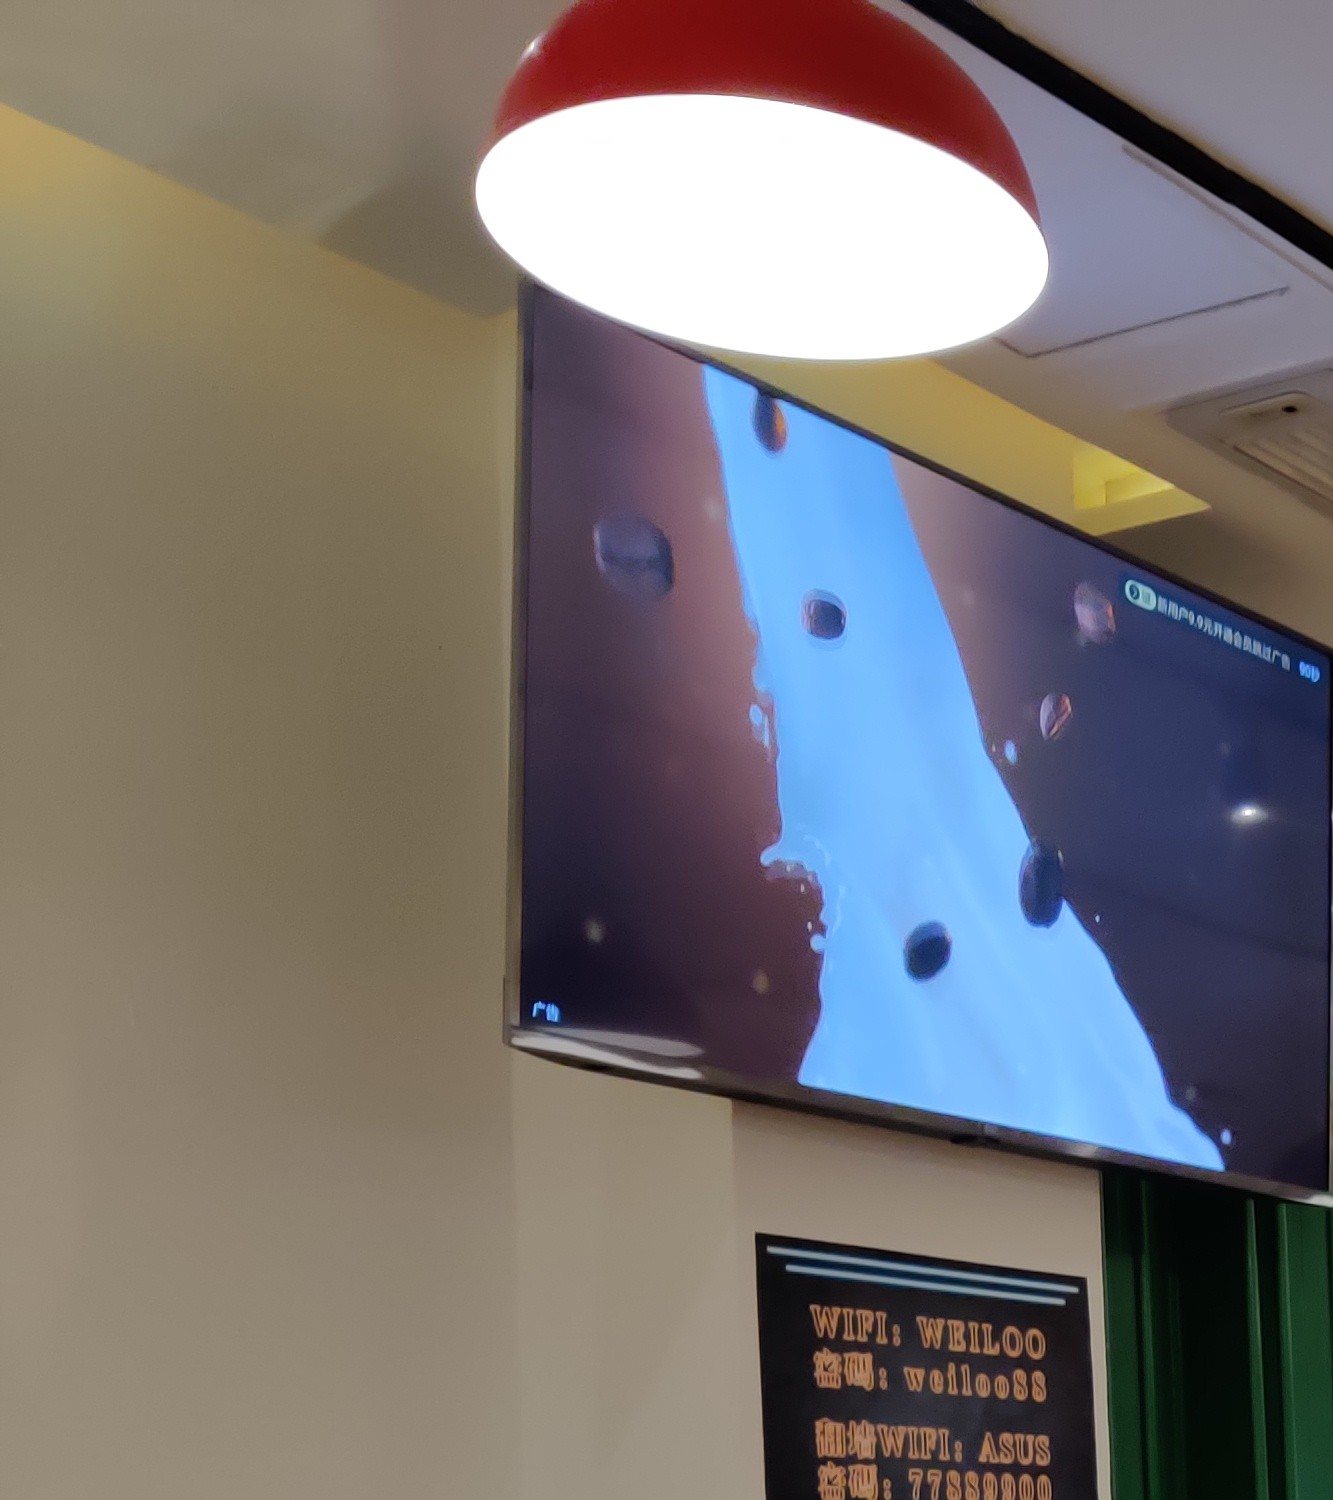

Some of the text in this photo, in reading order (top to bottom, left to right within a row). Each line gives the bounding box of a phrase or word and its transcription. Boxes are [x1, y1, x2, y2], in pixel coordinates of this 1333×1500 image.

[916, 1315, 1047, 1360] WEILOO
[903, 1361, 1047, 1402] weiloo88
[978, 1431, 1051, 1466] ASUS
